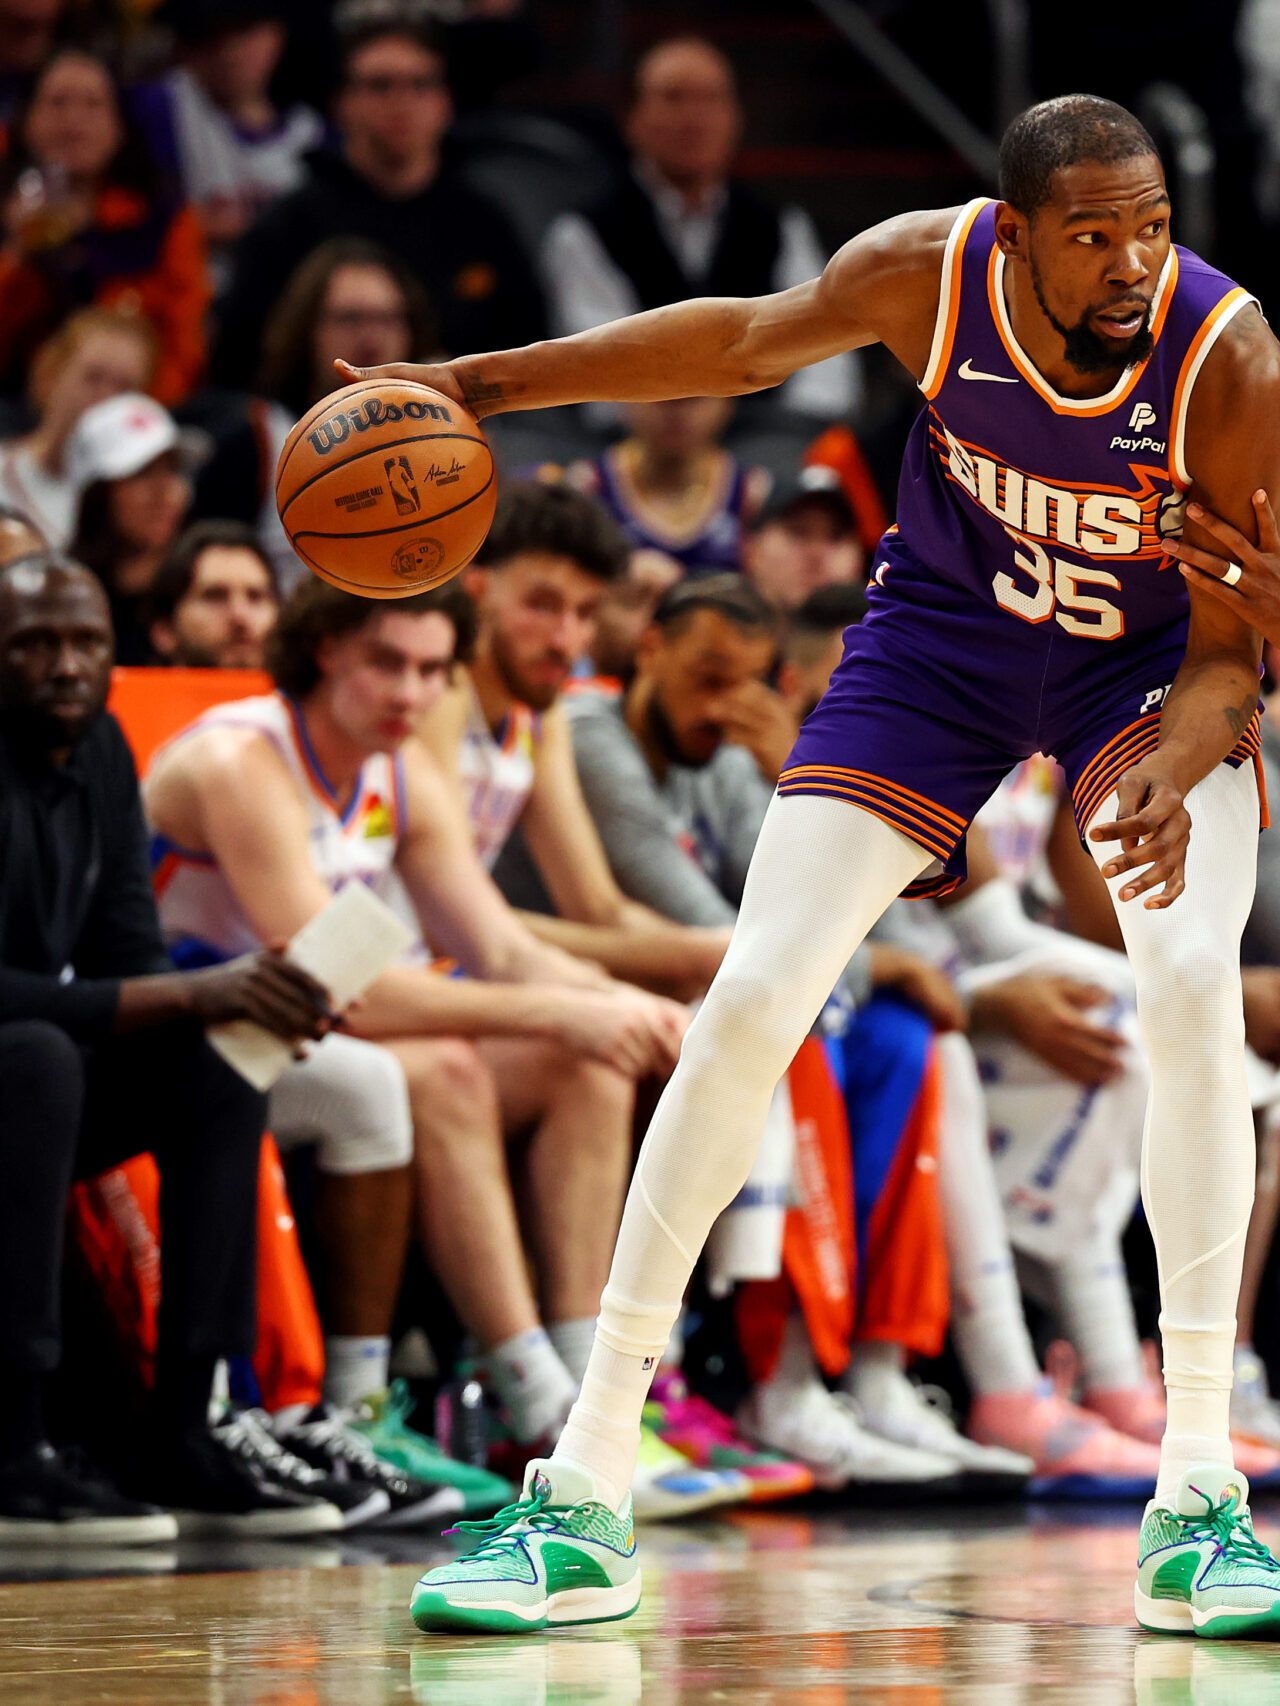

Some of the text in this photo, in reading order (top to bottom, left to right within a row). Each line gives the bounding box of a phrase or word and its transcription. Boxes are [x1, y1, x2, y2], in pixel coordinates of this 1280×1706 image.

[307, 399, 455, 455] Wilson
[1110, 436, 1166, 454] PayPal
[944, 428, 1142, 554] SUNS
[992, 525, 1124, 640] 35
